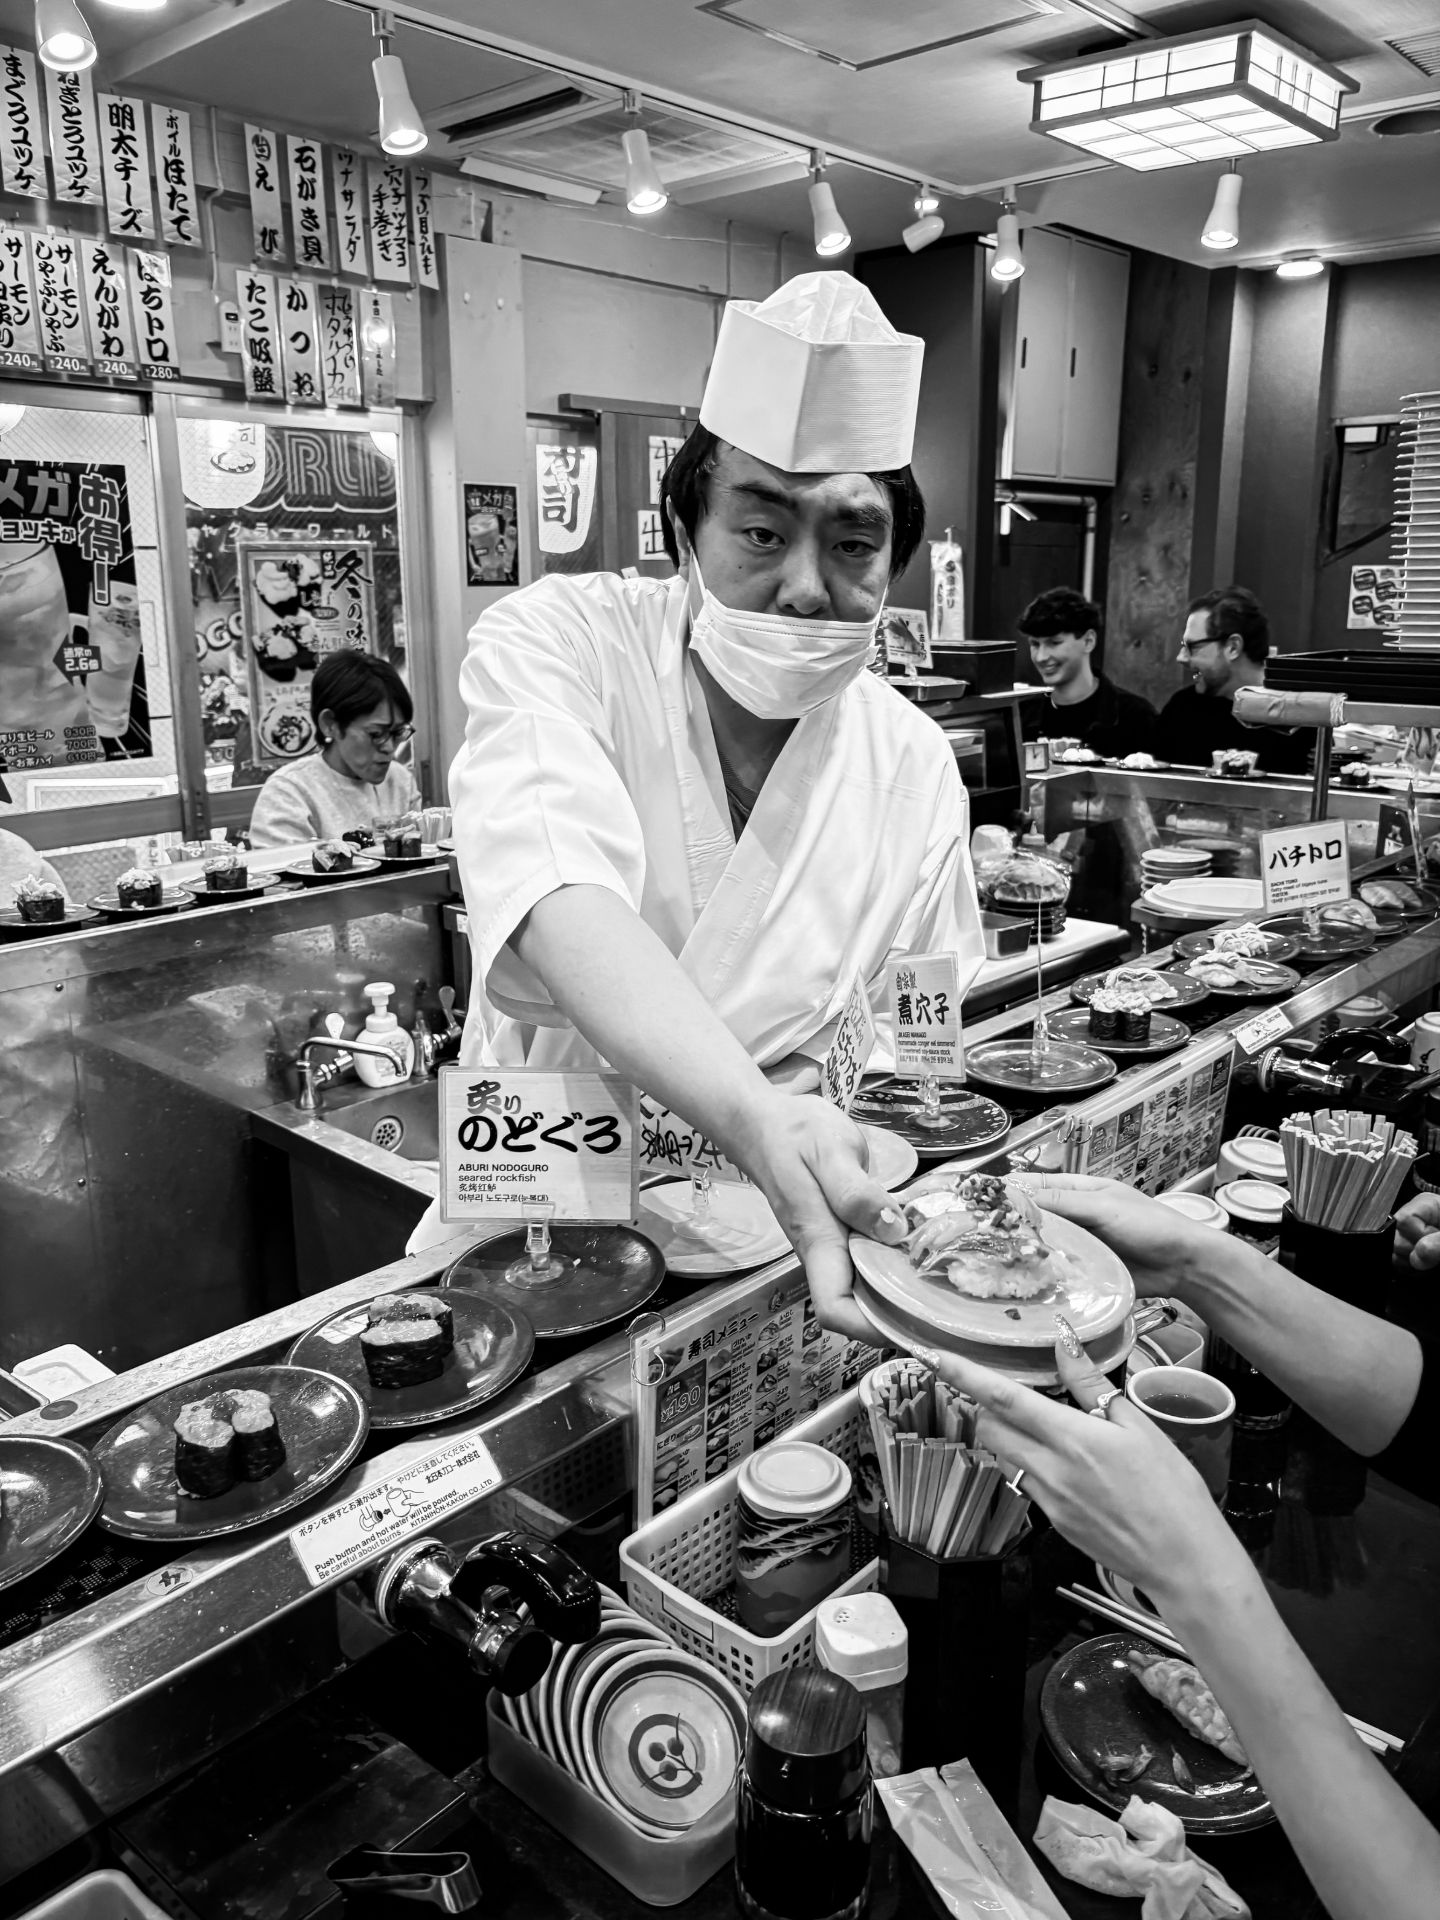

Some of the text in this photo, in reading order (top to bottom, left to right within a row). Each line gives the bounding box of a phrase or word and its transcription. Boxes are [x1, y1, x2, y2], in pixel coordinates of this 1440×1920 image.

[107, 103, 142, 232] 明太チーズ
[4, 236, 30, 326] サーモン
[56, 244, 79, 329] サーモン
[92, 247, 124, 357] えんがわ
[1269, 839, 1342, 870] バチトロ
[898, 992, 950, 1025] 煮穴子
[467, 1080, 521, 1114] 炙り
[458, 1111, 621, 1154] のどぐろ
[458, 1163, 549, 1172] ABURI NODOGURO
[458, 1173, 536, 1182] seared rockfish
[458, 1193, 483, 1202] 아부리
[687, 1312, 759, 1361] 寿司メニュー
[397, 1441, 475, 1484] やけどに注意してください。
[299, 1484, 393, 1537] ボタンを押すとお湯が出ます。
[314, 1489, 459, 1573] Push button and hot water will be poured.
[410, 1492, 468, 1528] KITANIHON-KAKOH
[318, 1530, 405, 1580] Be careful about burns.
